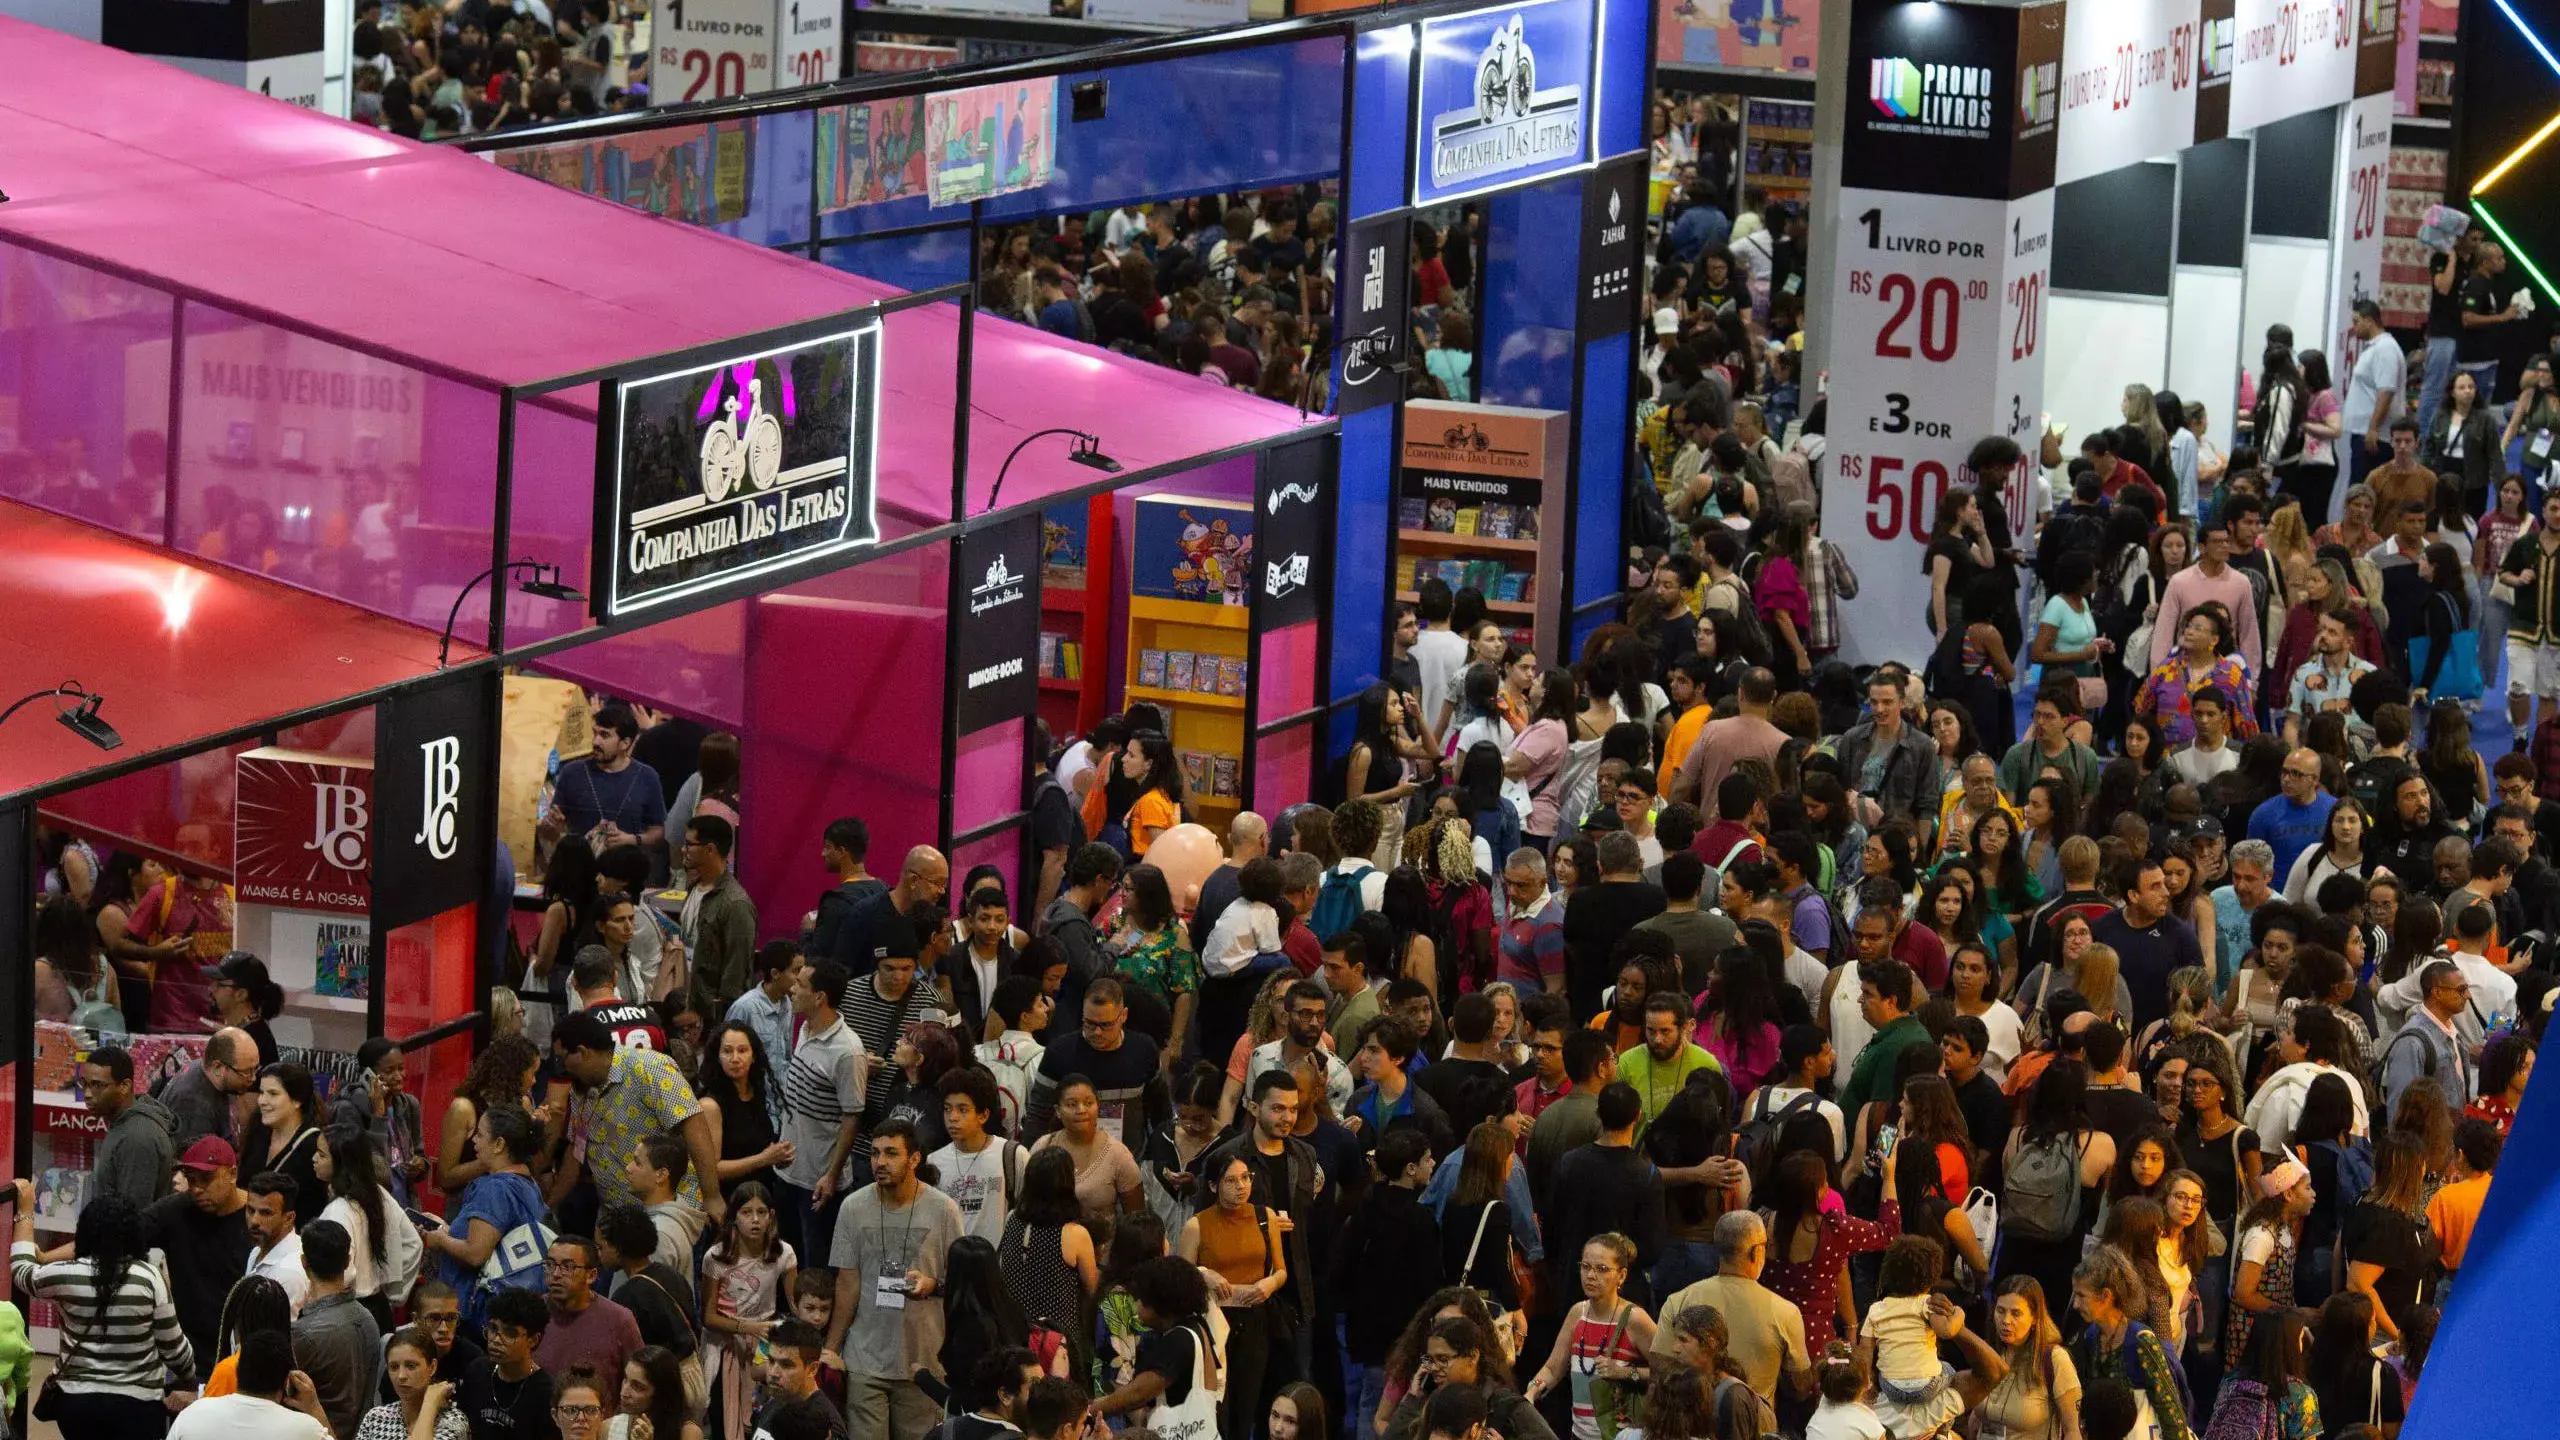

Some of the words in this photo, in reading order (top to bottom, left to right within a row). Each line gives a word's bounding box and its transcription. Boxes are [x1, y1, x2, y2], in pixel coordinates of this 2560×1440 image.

[687, 20, 730, 34] LIVRO
[734, 23, 764, 37] POR
[1924, 63, 1992, 98] PROMO
[1921, 94, 1992, 129] LIVROS
[1532, 120, 1578, 153] LETRAS
[1601, 224, 1626, 247] ZAHAR
[1859, 208, 1882, 250] 1
[1886, 235, 1941, 255] LIVRO
[1947, 240, 1985, 259] POR
[1850, 270, 1873, 296] R$
[201, 360, 270, 401] MAIS
[1869, 416, 1878, 433] E
[1883, 392, 1911, 434] 3
[1914, 420, 1952, 439] POR
[1490, 453, 1529, 468] LETRAS
[1840, 453, 1863, 480] R$
[1424, 476, 1450, 490] MAIS
[1452, 479, 1508, 496] VENDIDOS
[630, 514, 739, 575] COMPANHIA
[740, 498, 777, 544] DAS
[779, 485, 845, 533] LETRAS
[414, 735, 461, 861] JBC
[303, 782, 369, 871] JBC
[242, 884, 289, 899] MANGÁ
[305, 890, 314, 902] A
[318, 892, 367, 908] NOSSA
